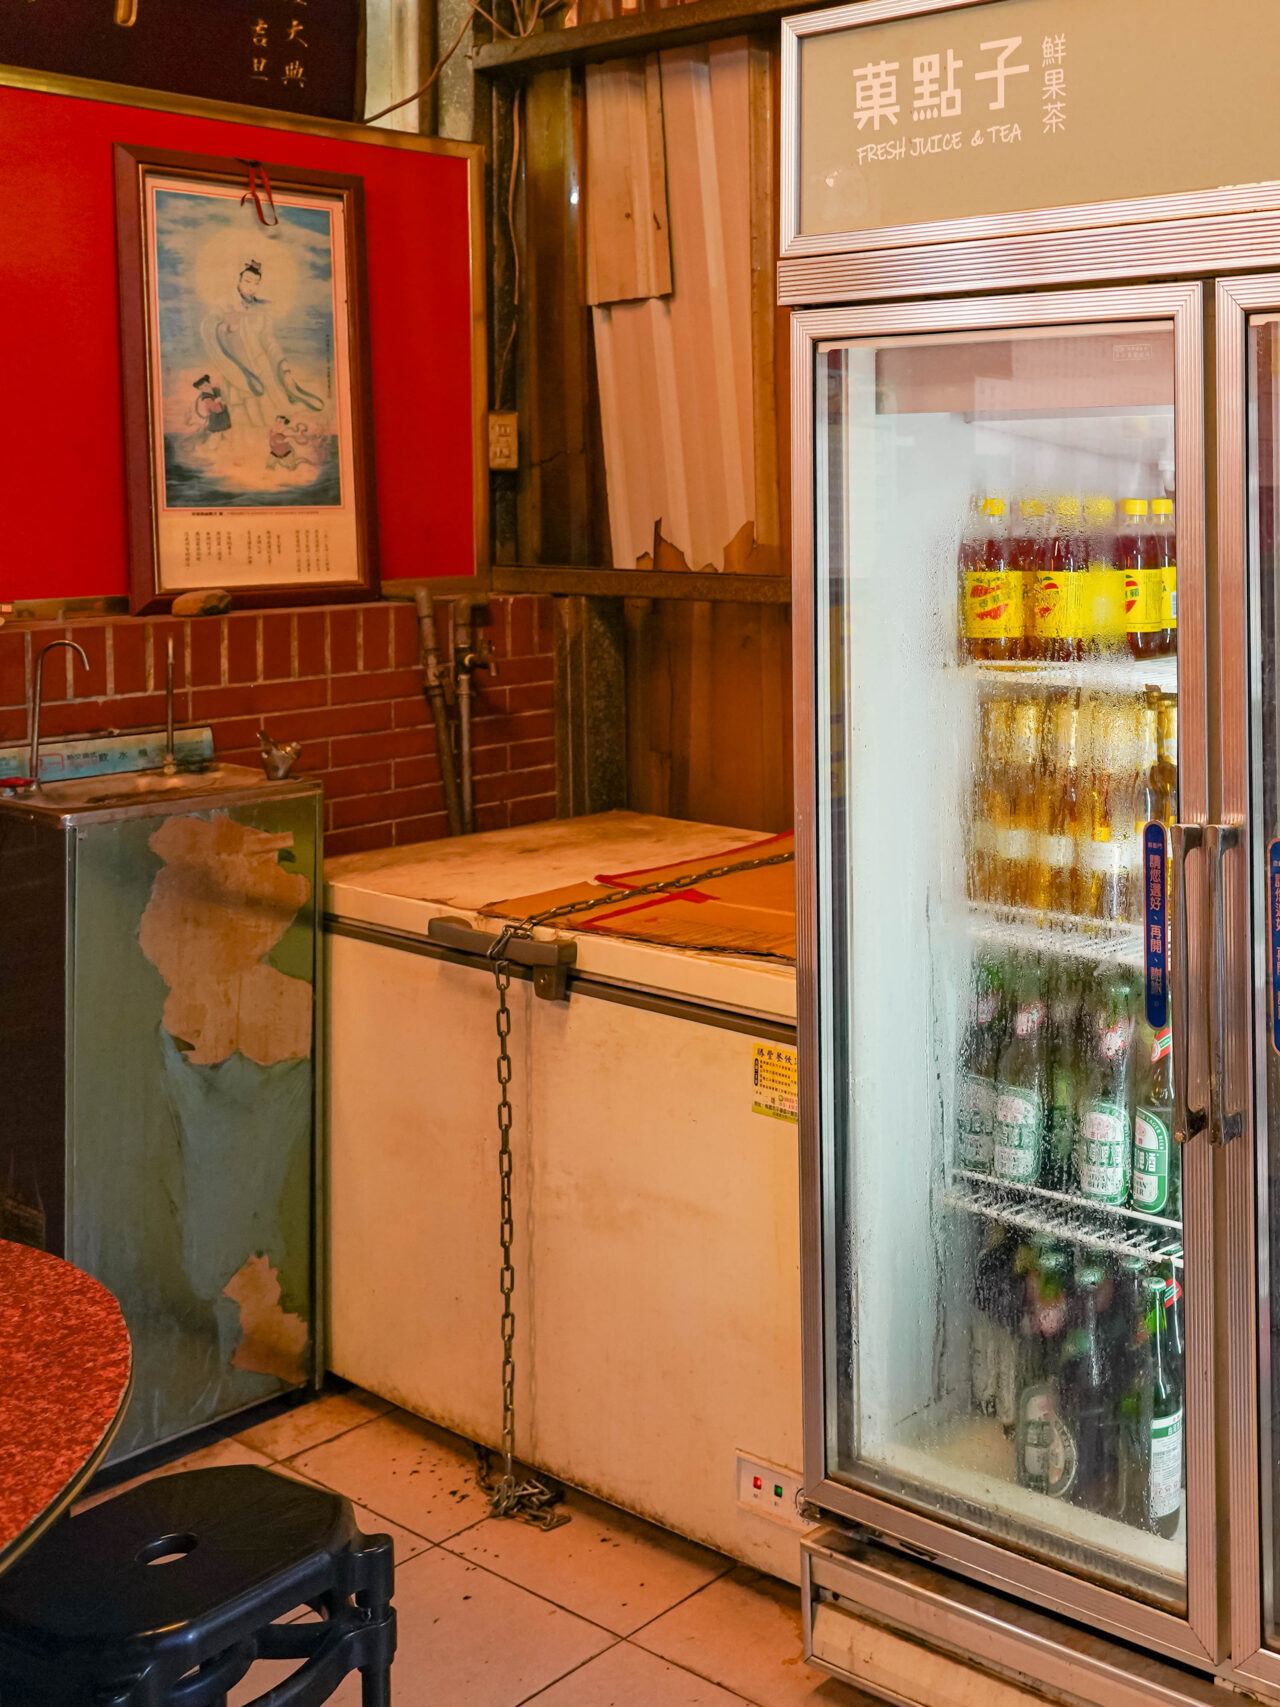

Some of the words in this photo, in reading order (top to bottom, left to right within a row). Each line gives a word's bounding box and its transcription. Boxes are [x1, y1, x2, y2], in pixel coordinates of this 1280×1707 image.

[282, 0, 308, 88] 大典
[852, 35, 1030, 131] 菓點子
[1041, 34, 1067, 134] 鮮果茶
[857, 137, 906, 164] FRESH
[910, 131, 962, 157] JUICE
[971, 129, 984, 147] &
[988, 123, 1022, 144] TEA
